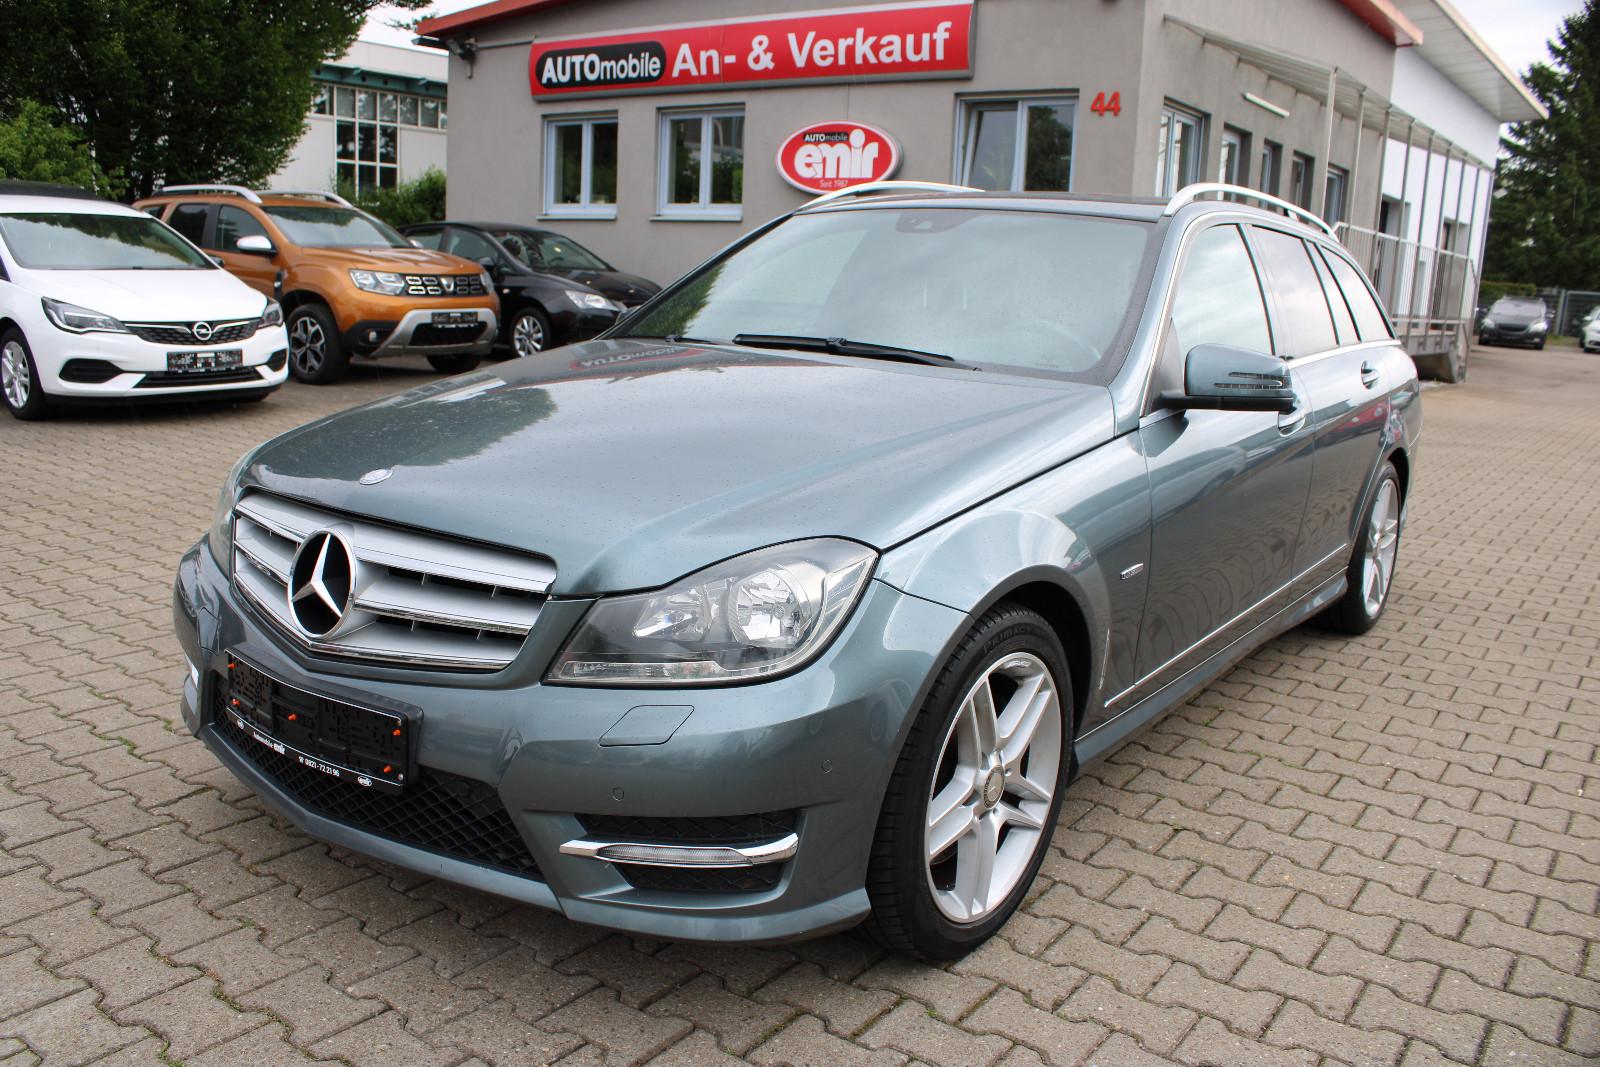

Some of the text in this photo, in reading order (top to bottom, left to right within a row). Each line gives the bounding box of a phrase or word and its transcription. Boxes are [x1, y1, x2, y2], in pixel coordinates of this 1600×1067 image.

[541, 21, 952, 84] AUTOmobile An- & Verkauf
[1091, 91, 1121, 117] 44
[794, 128, 879, 179] emir
[804, 133, 849, 142] AUTOmobile
